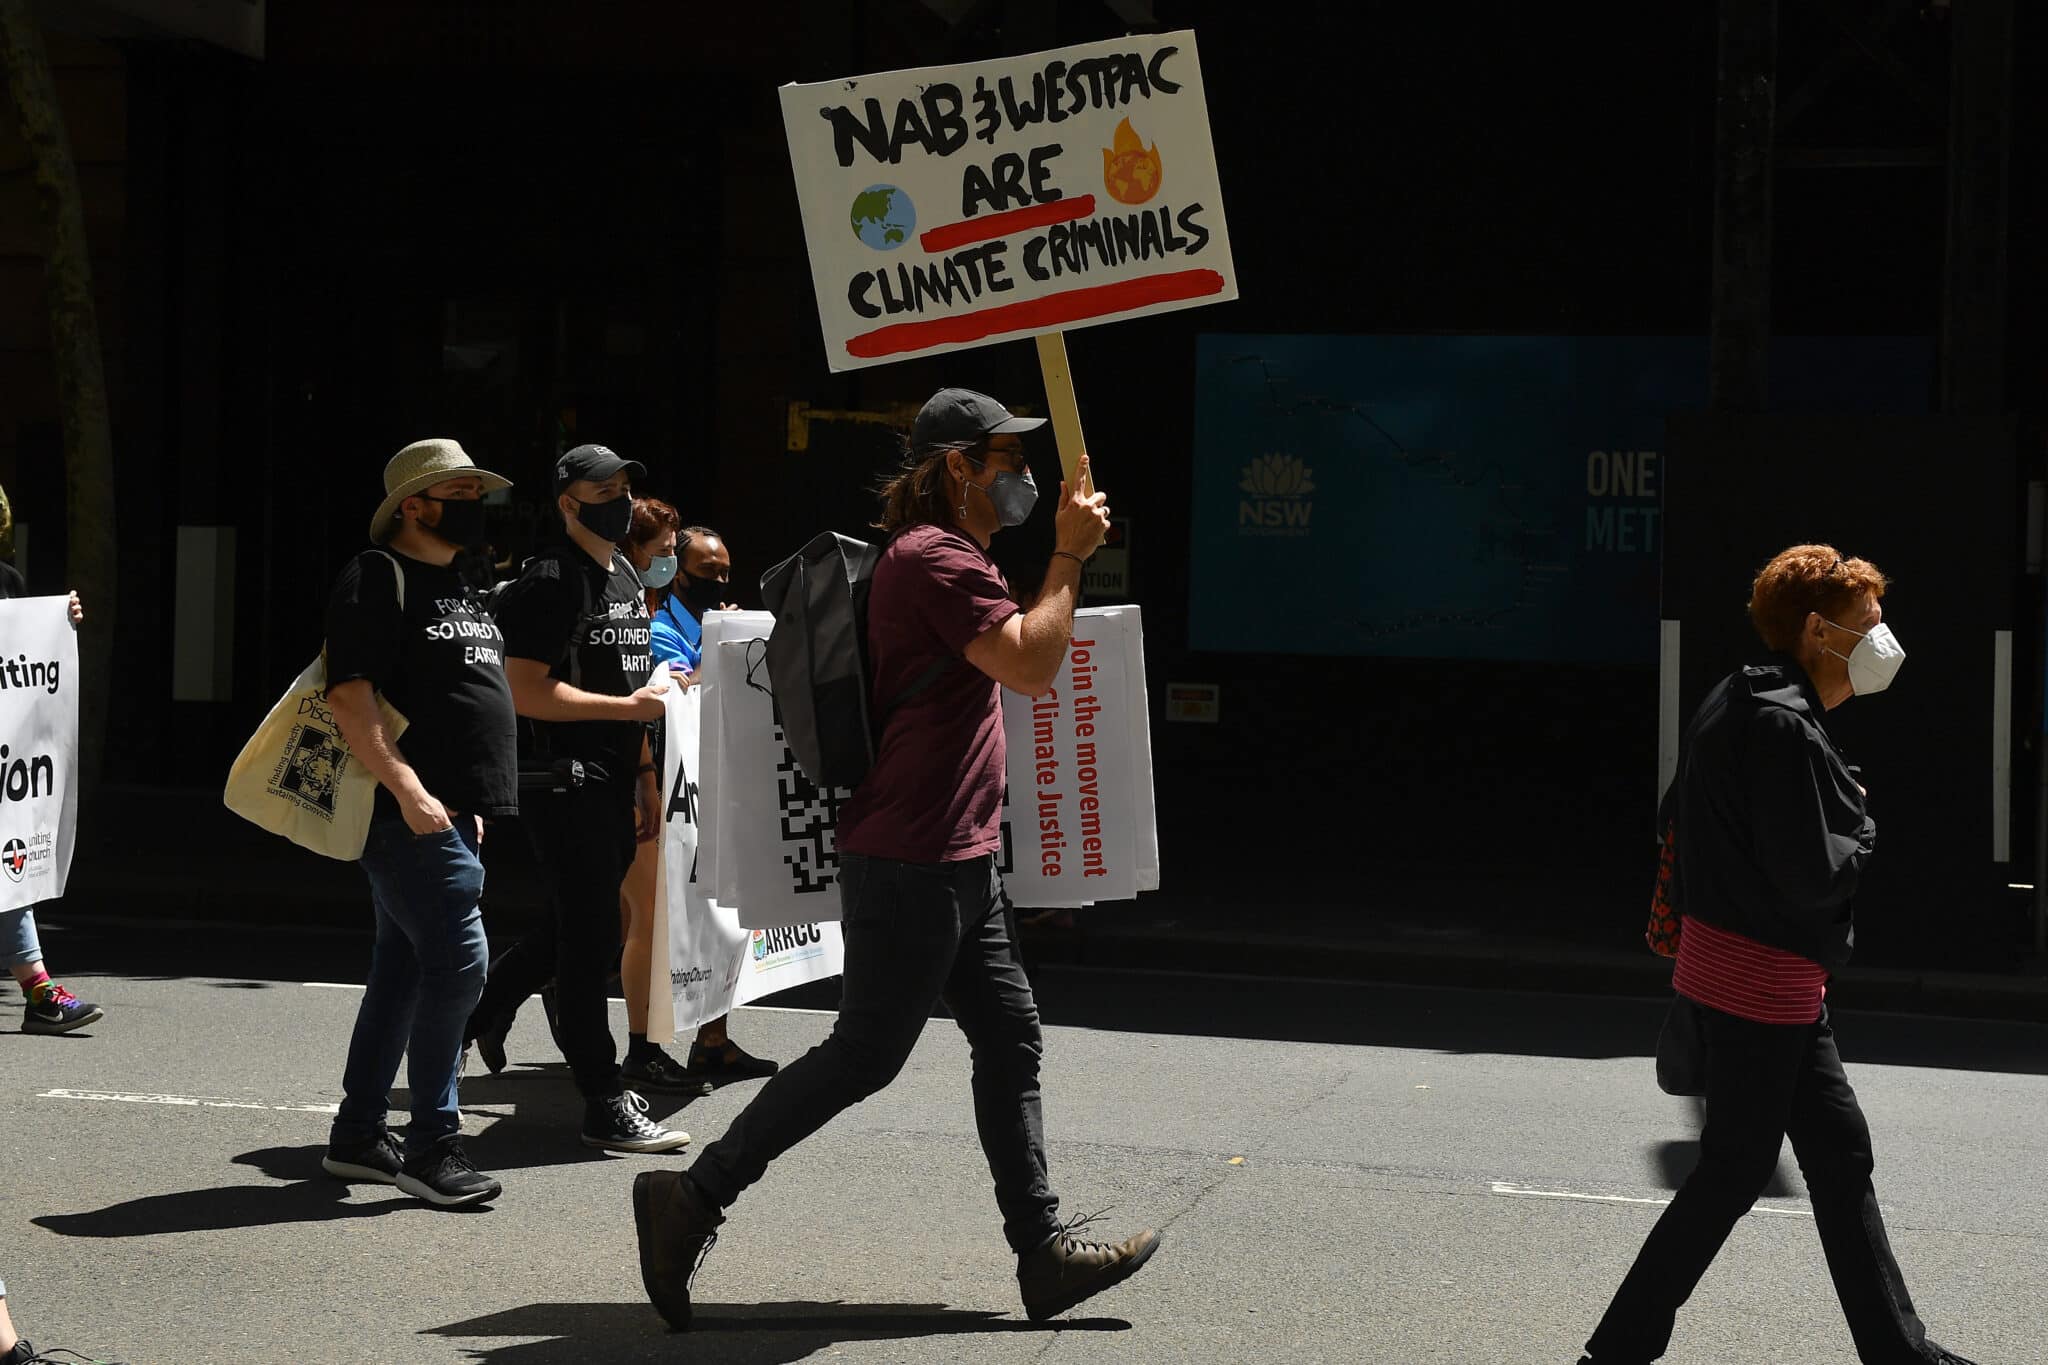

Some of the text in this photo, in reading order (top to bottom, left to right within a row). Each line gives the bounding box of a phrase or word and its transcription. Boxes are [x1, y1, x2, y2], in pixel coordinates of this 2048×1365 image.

[820, 84, 968, 166] NAB
[999, 46, 1184, 131] WESTPAC
[962, 144, 1063, 217] ARE
[848, 203, 1210, 318] CLIMATE CRIMINALS
[1586, 450, 1656, 497] ONE
[1238, 500, 1312, 528] NSW
[1585, 505, 1660, 552] MET
[425, 622, 454, 640] SO
[588, 627, 649, 646] SO LOVED
[465, 646, 501, 666] EARTH
[621, 654, 651, 672] EARTH
[1070, 637, 1108, 878] Join the movement
[1037, 793, 1067, 878] Justice
